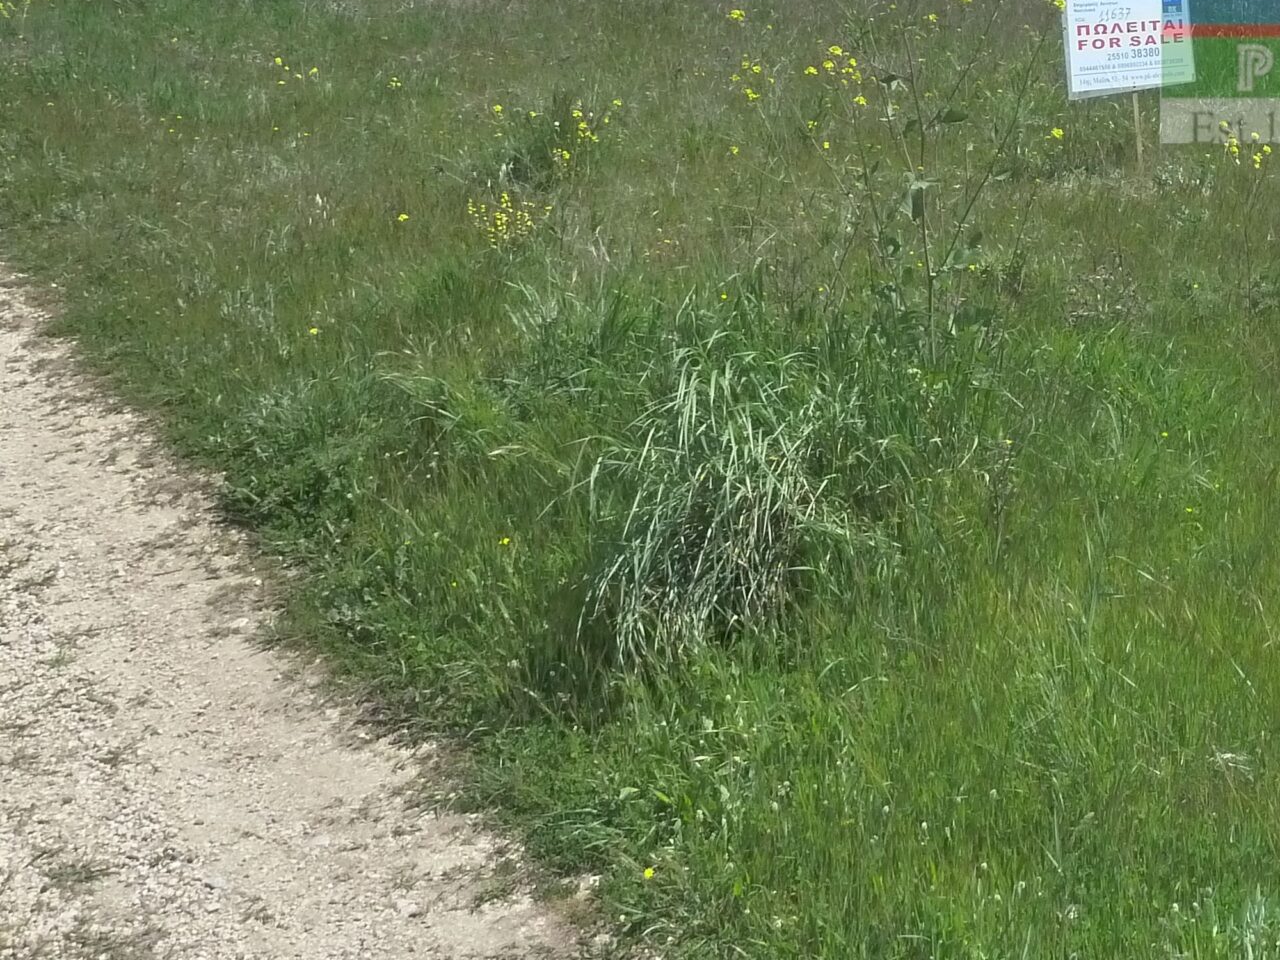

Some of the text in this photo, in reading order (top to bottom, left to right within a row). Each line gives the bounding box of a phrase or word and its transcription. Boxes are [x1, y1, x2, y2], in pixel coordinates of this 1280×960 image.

[1077, 19, 1183, 36] ΠΩΛΕΙΤΑΙ
[1078, 33, 1184, 51] FOR SALE
[1130, 47, 1160, 59] 38380
